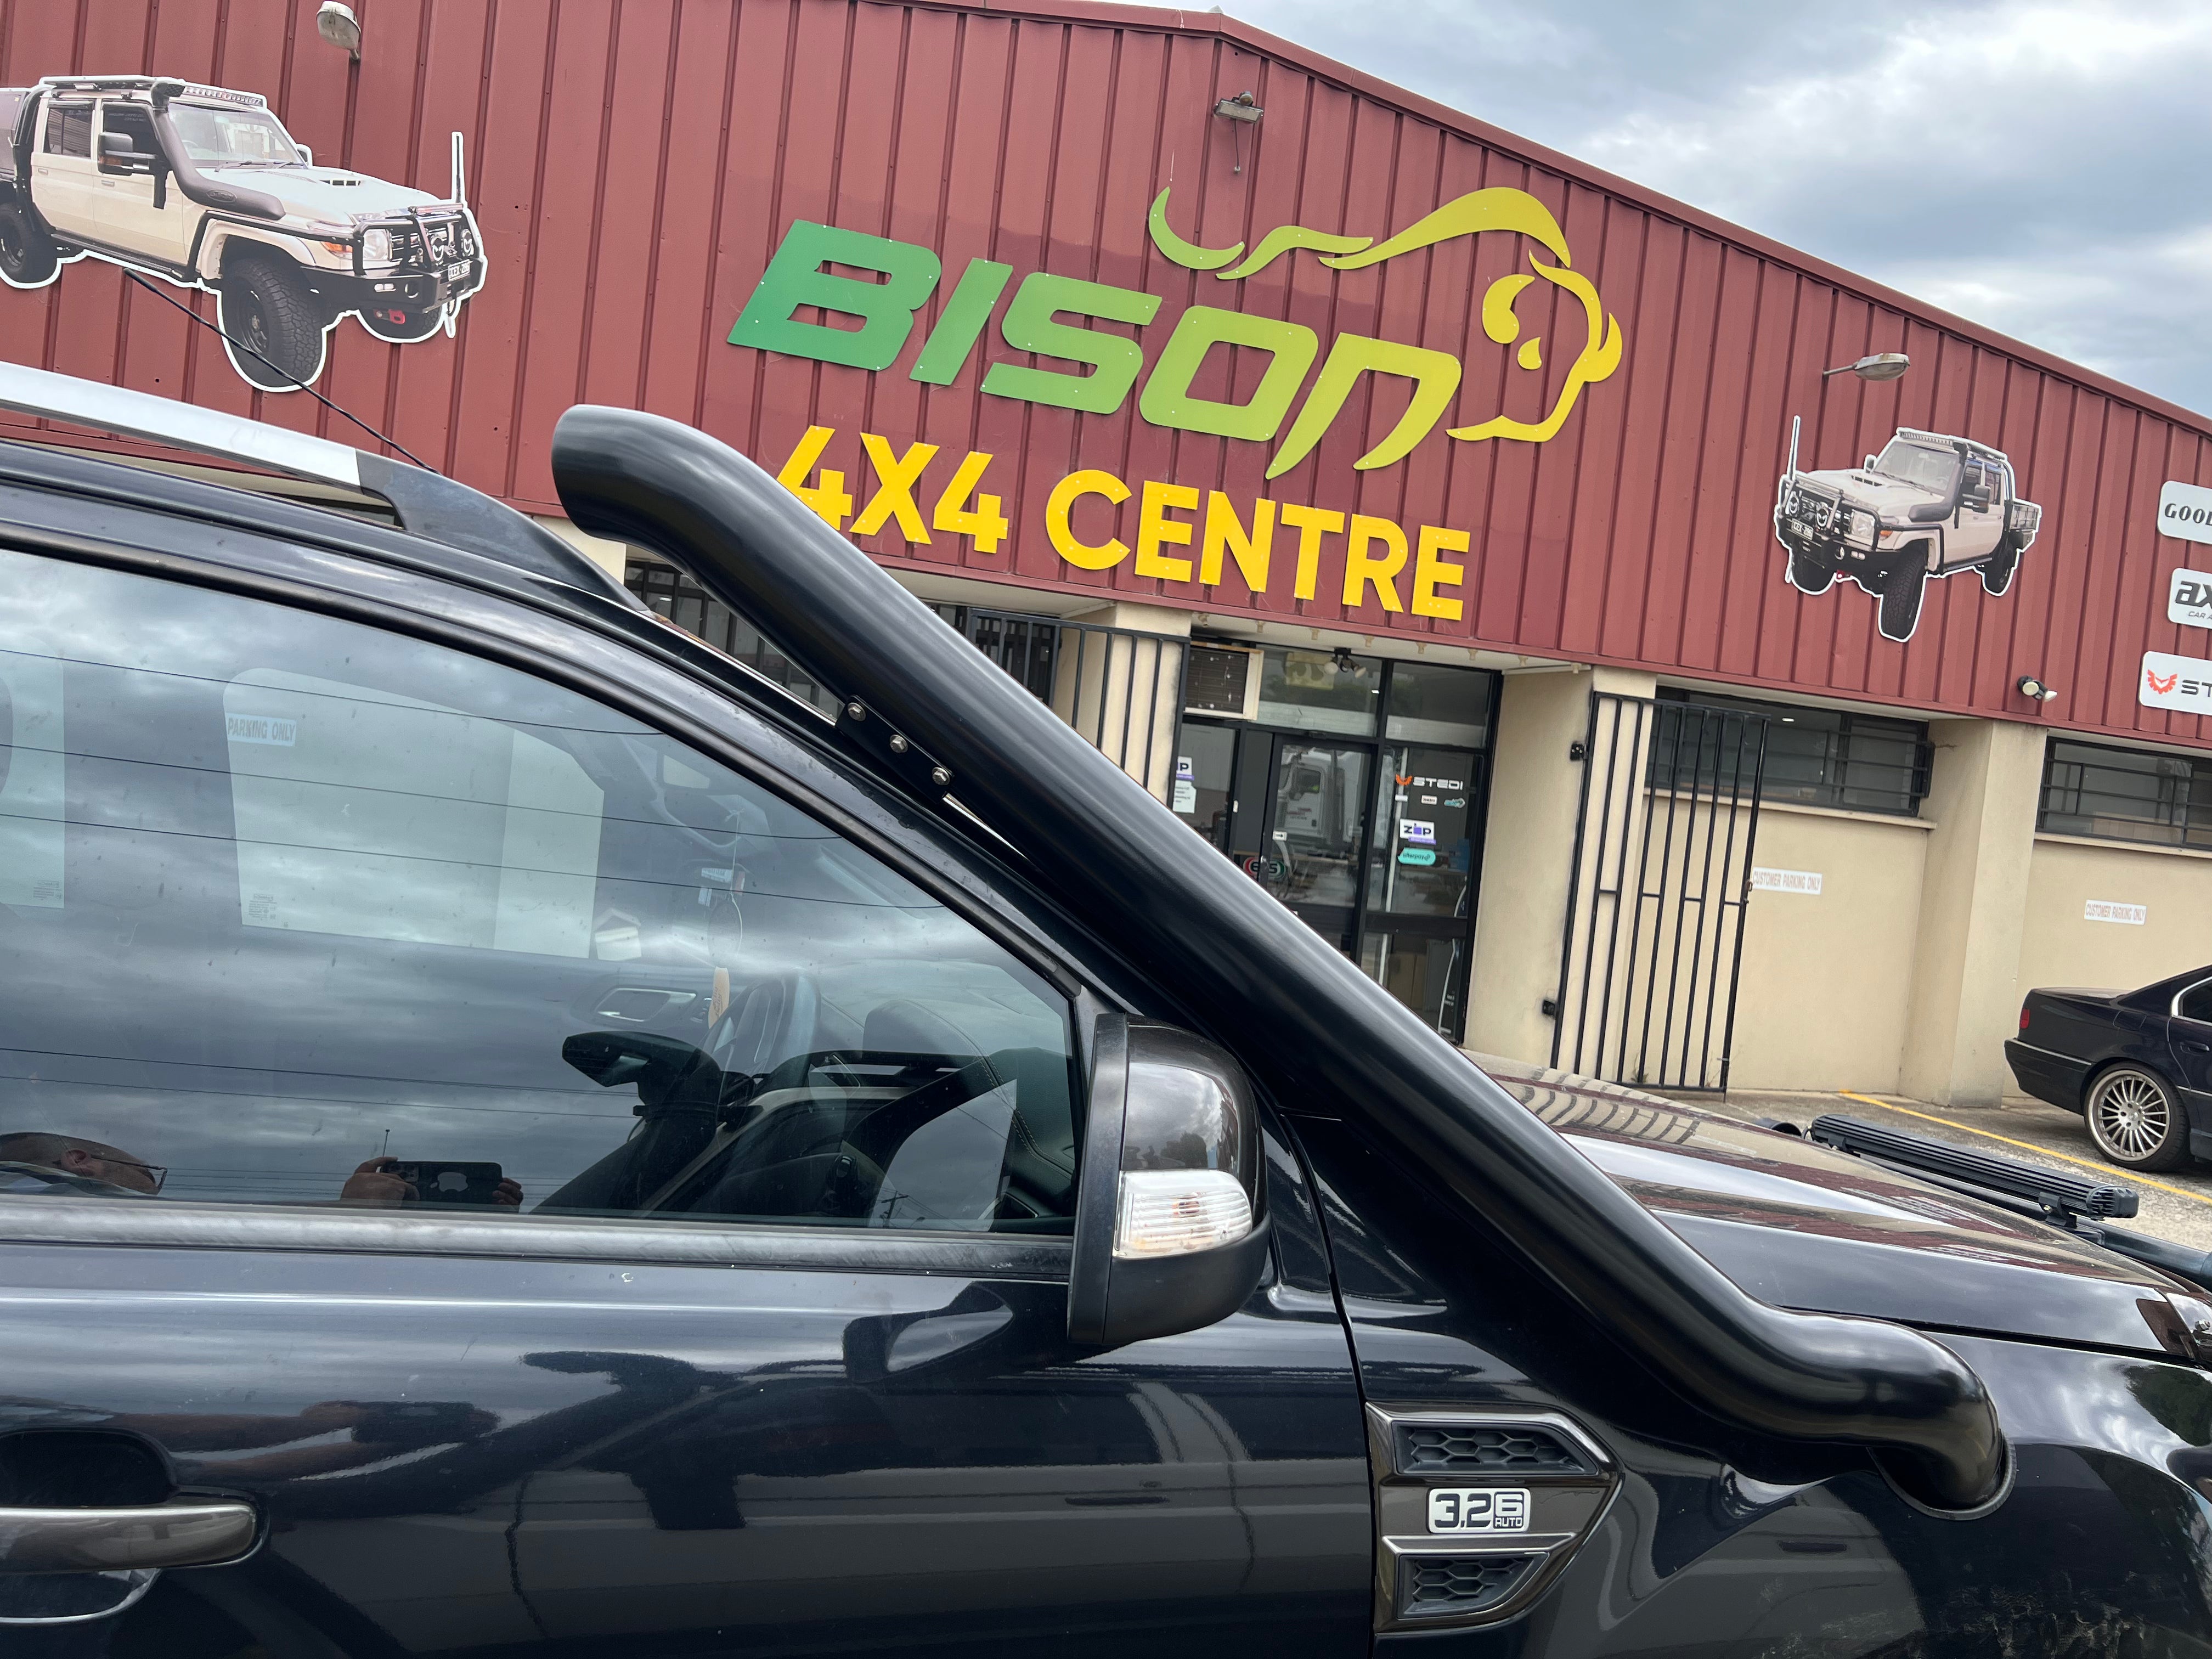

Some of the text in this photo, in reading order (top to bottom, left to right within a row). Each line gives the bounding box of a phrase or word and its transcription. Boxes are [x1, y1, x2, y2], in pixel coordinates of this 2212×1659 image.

[777, 425, 1471, 622] 4X4 CENTRE
[228, 717, 296, 741] PARKING ONLY
[1413, 776, 1463, 791] STEDI
[1753, 871, 1821, 891] CUSTOMER PARKING ONLY
[2086, 904, 2146, 921] CUSTOMER PARKING ONLY
[1495, 1517, 1523, 1527] AUTO
